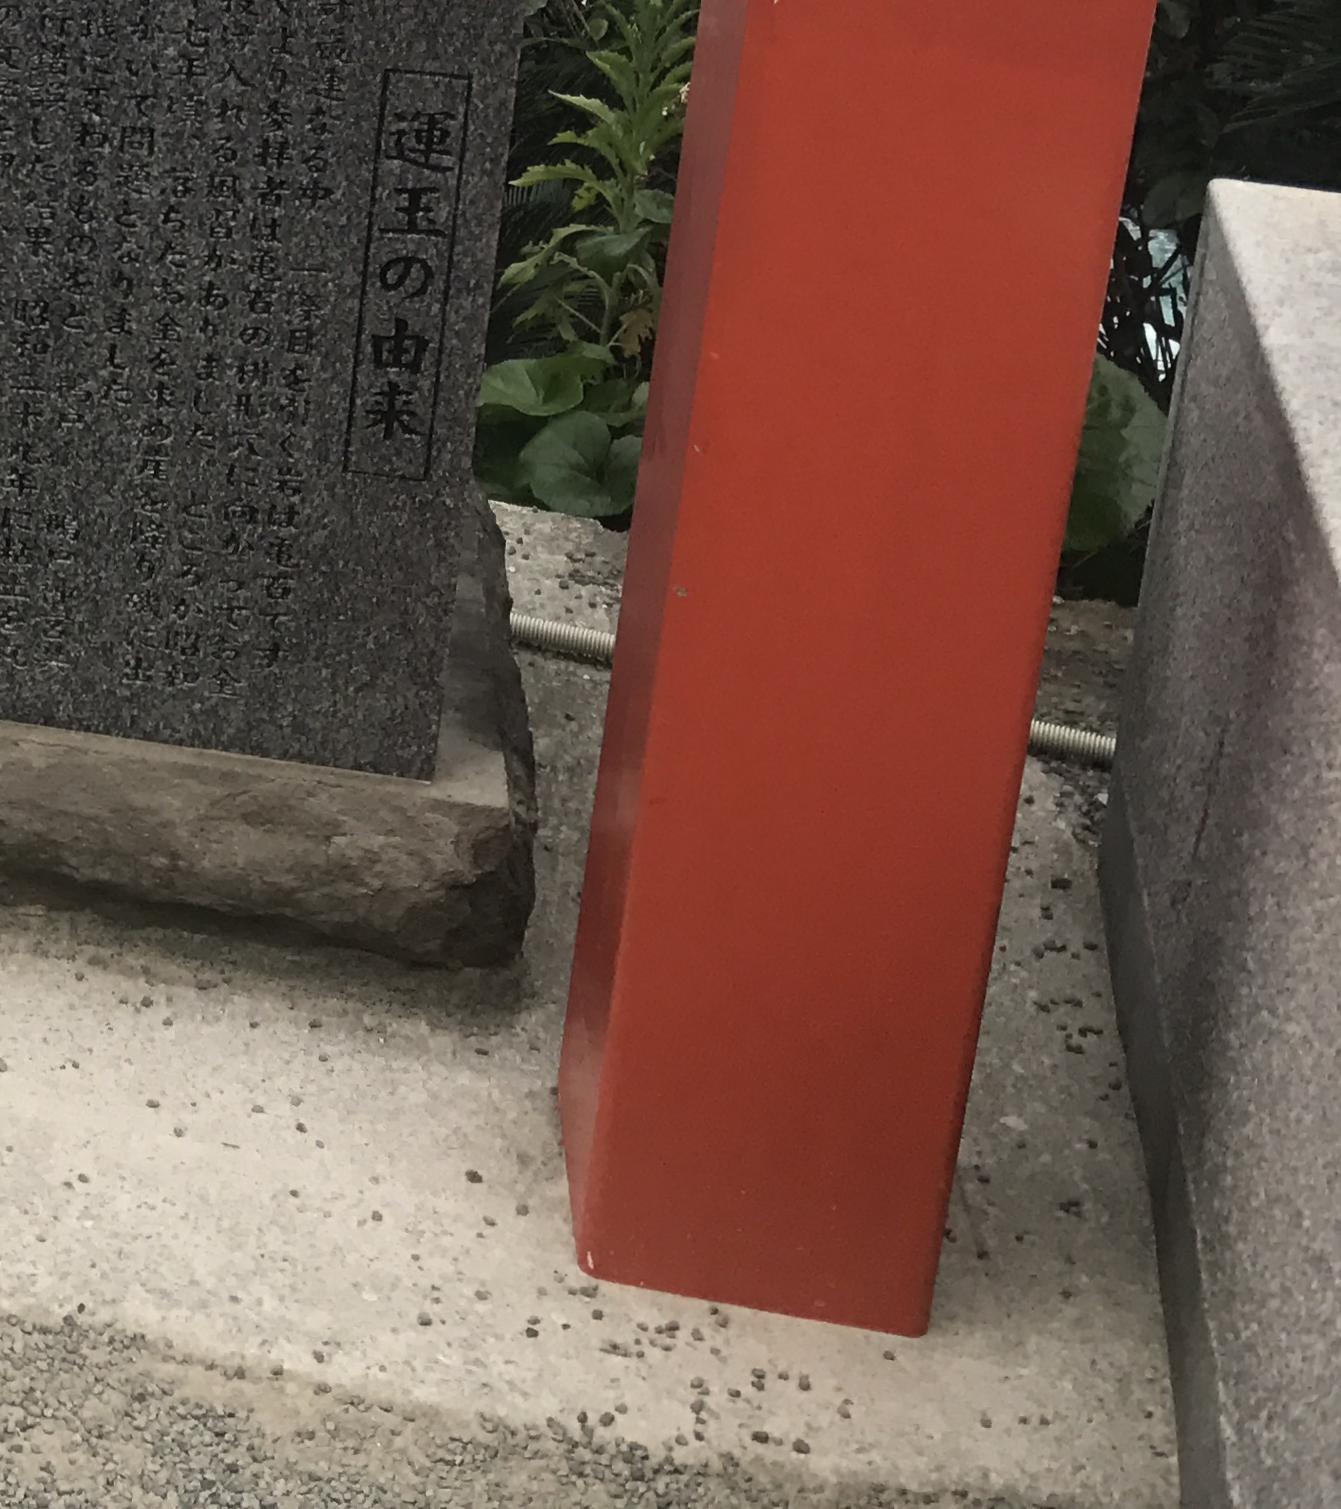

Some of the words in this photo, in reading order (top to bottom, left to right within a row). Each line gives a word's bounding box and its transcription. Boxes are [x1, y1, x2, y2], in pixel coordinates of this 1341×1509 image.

[365, 110, 457, 441] 運玉の由来
